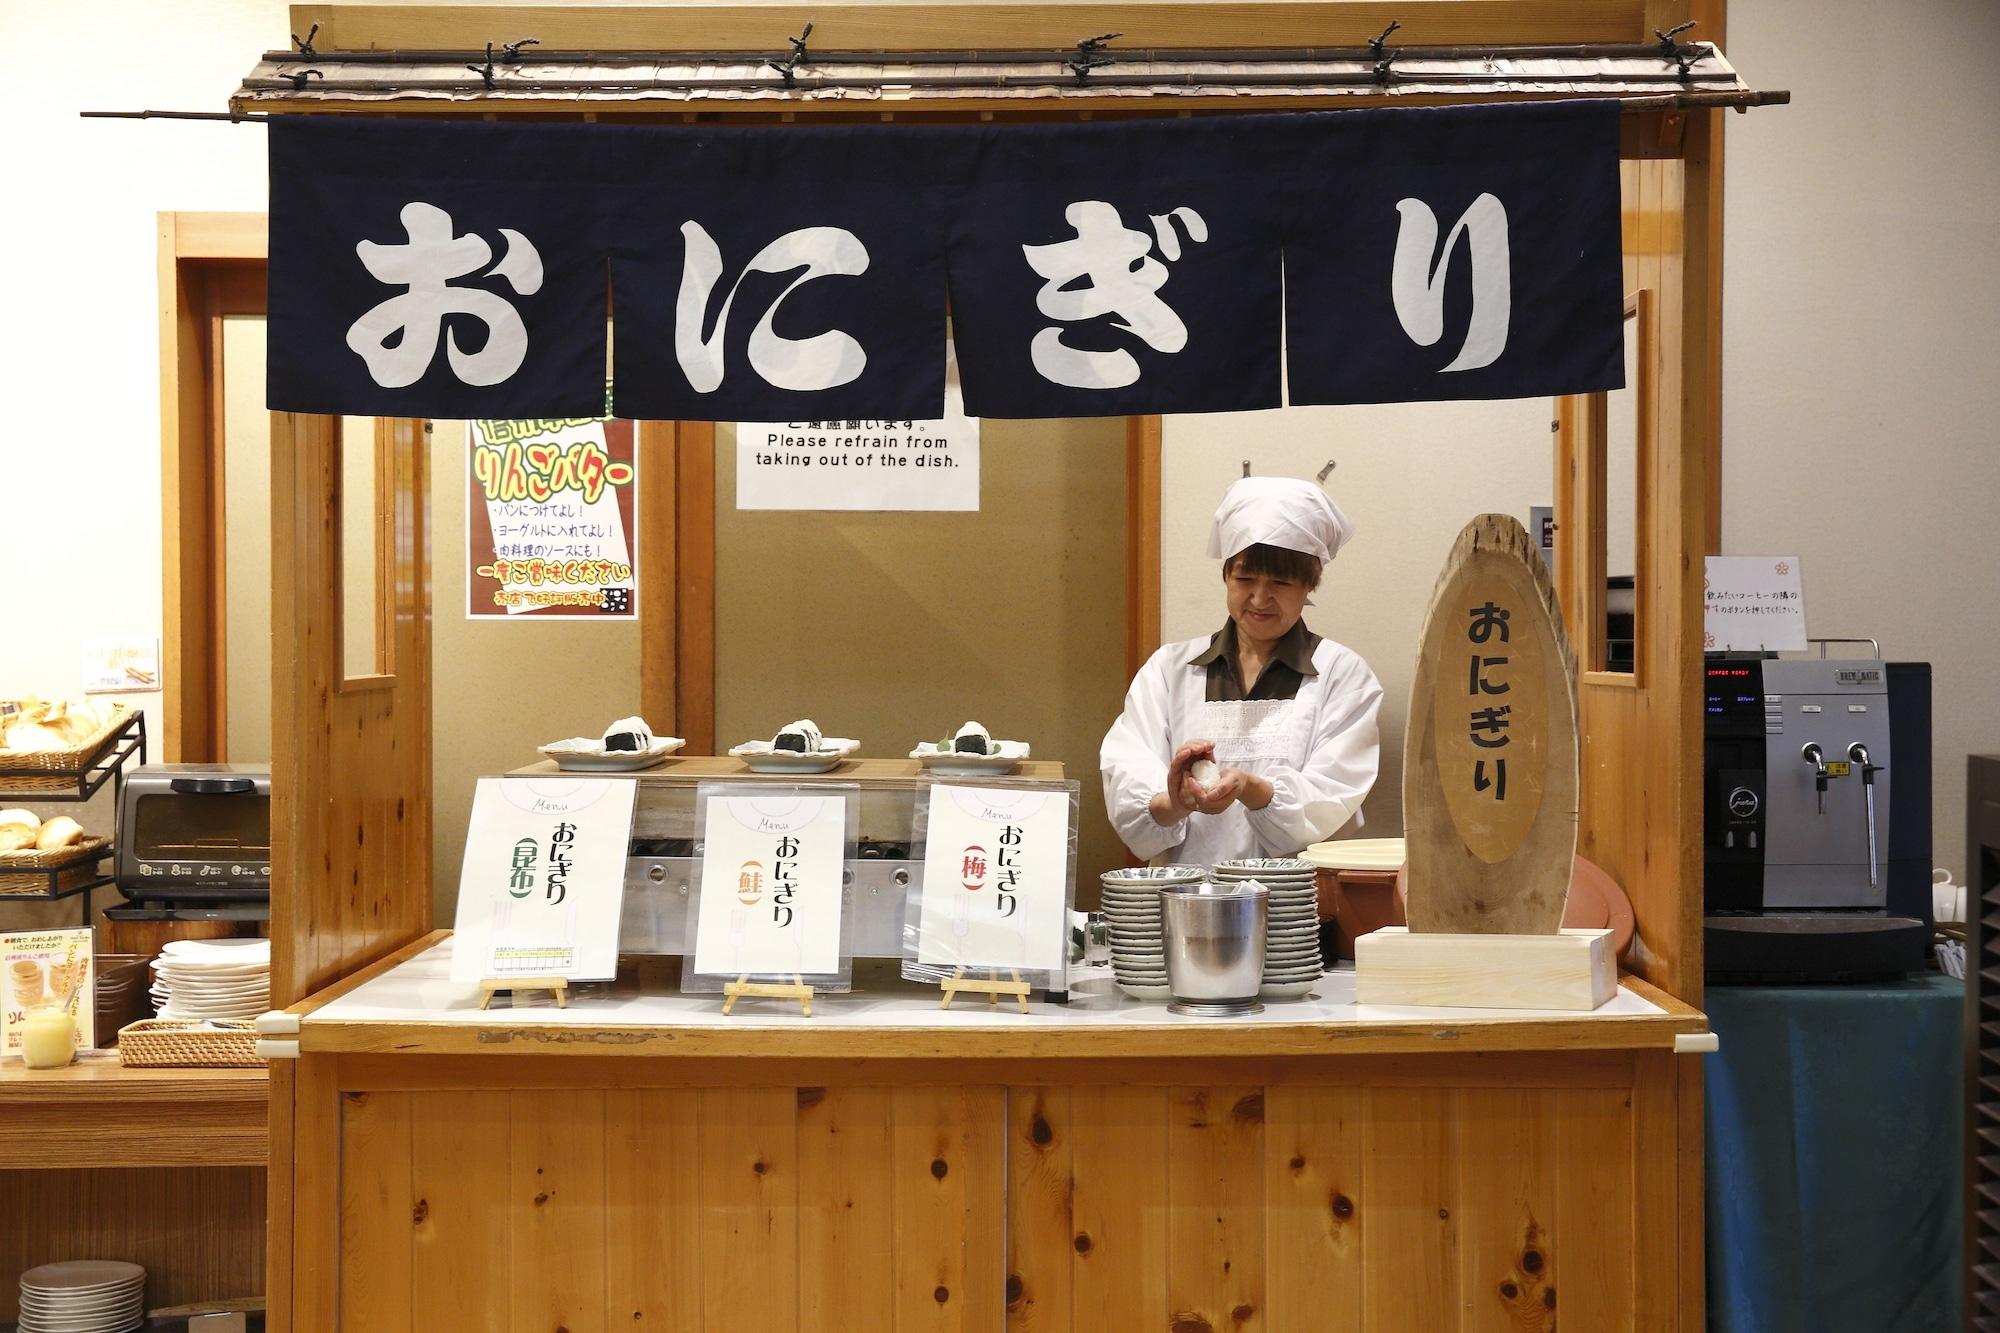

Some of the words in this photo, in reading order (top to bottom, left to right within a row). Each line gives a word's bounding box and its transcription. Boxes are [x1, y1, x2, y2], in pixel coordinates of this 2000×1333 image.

[346, 191, 1511, 392] おにぎり
[474, 441, 634, 504] りんごバター
[756, 452, 811, 467] taking
[819, 453, 848, 467] out
[855, 453, 873, 467] of
[880, 453, 907, 467] the
[915, 454, 959, 468] dish.
[767, 434, 827, 448] Please
[835, 434, 898, 449] refrain
[906, 435, 948, 449] from
[1468, 601, 1511, 801] おにぎり
[532, 798, 569, 811] Menu
[758, 817, 790, 832] Menu
[981, 808, 1013, 820] Menu
[546, 822, 577, 905] おにぎり
[773, 836, 800, 928] おにぎり
[996, 825, 1023, 918] おにぎり
